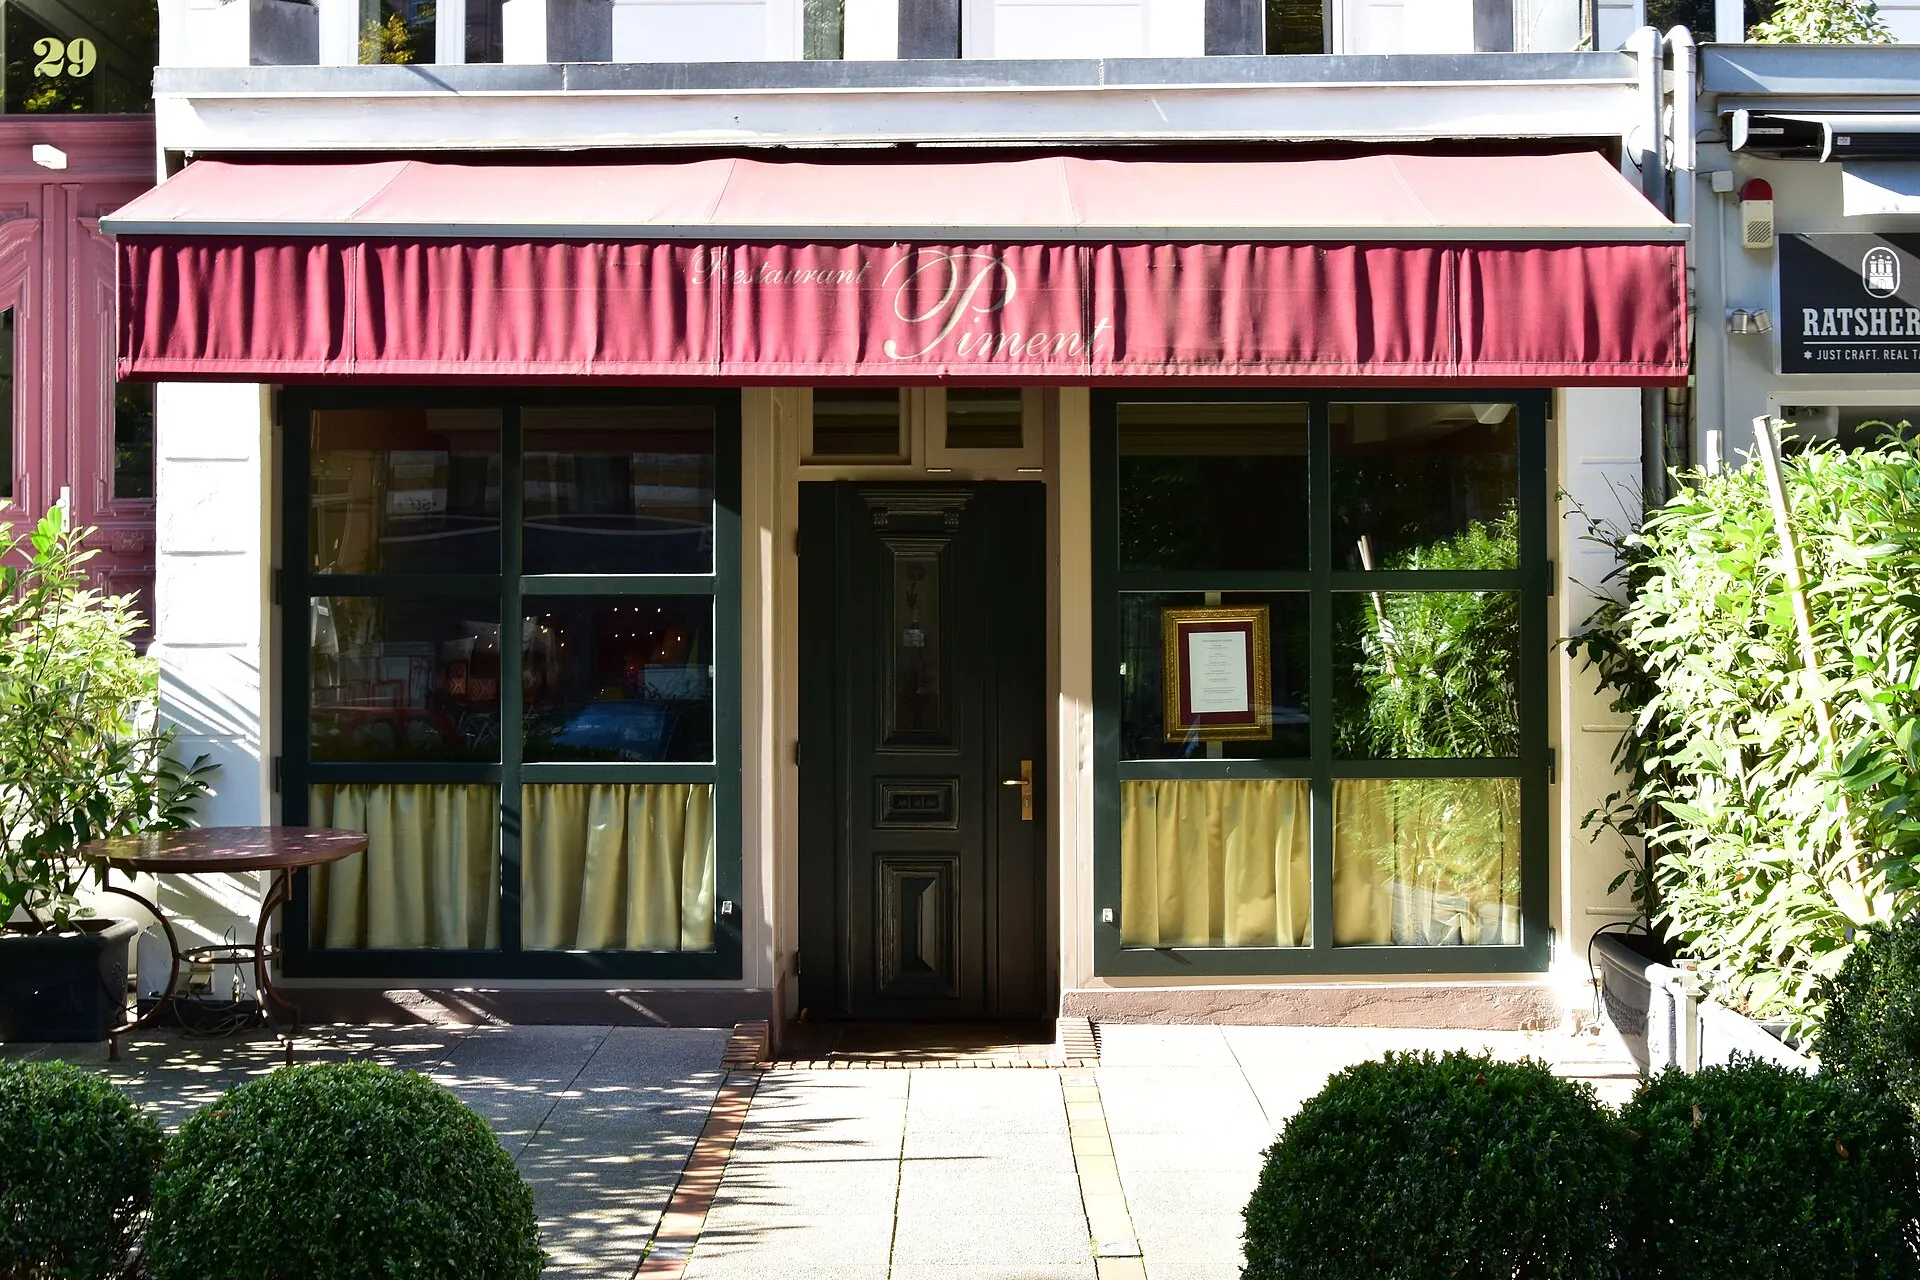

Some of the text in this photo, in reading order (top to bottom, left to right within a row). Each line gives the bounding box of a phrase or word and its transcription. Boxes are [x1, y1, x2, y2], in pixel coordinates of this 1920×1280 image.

[33, 37, 97, 78] 29
[691, 250, 872, 285] Restaurant
[882, 249, 1113, 360] Piment
[1802, 307, 1920, 337] RATSHER
[1816, 349, 1920, 360] JUST CRAFT. REAL T
